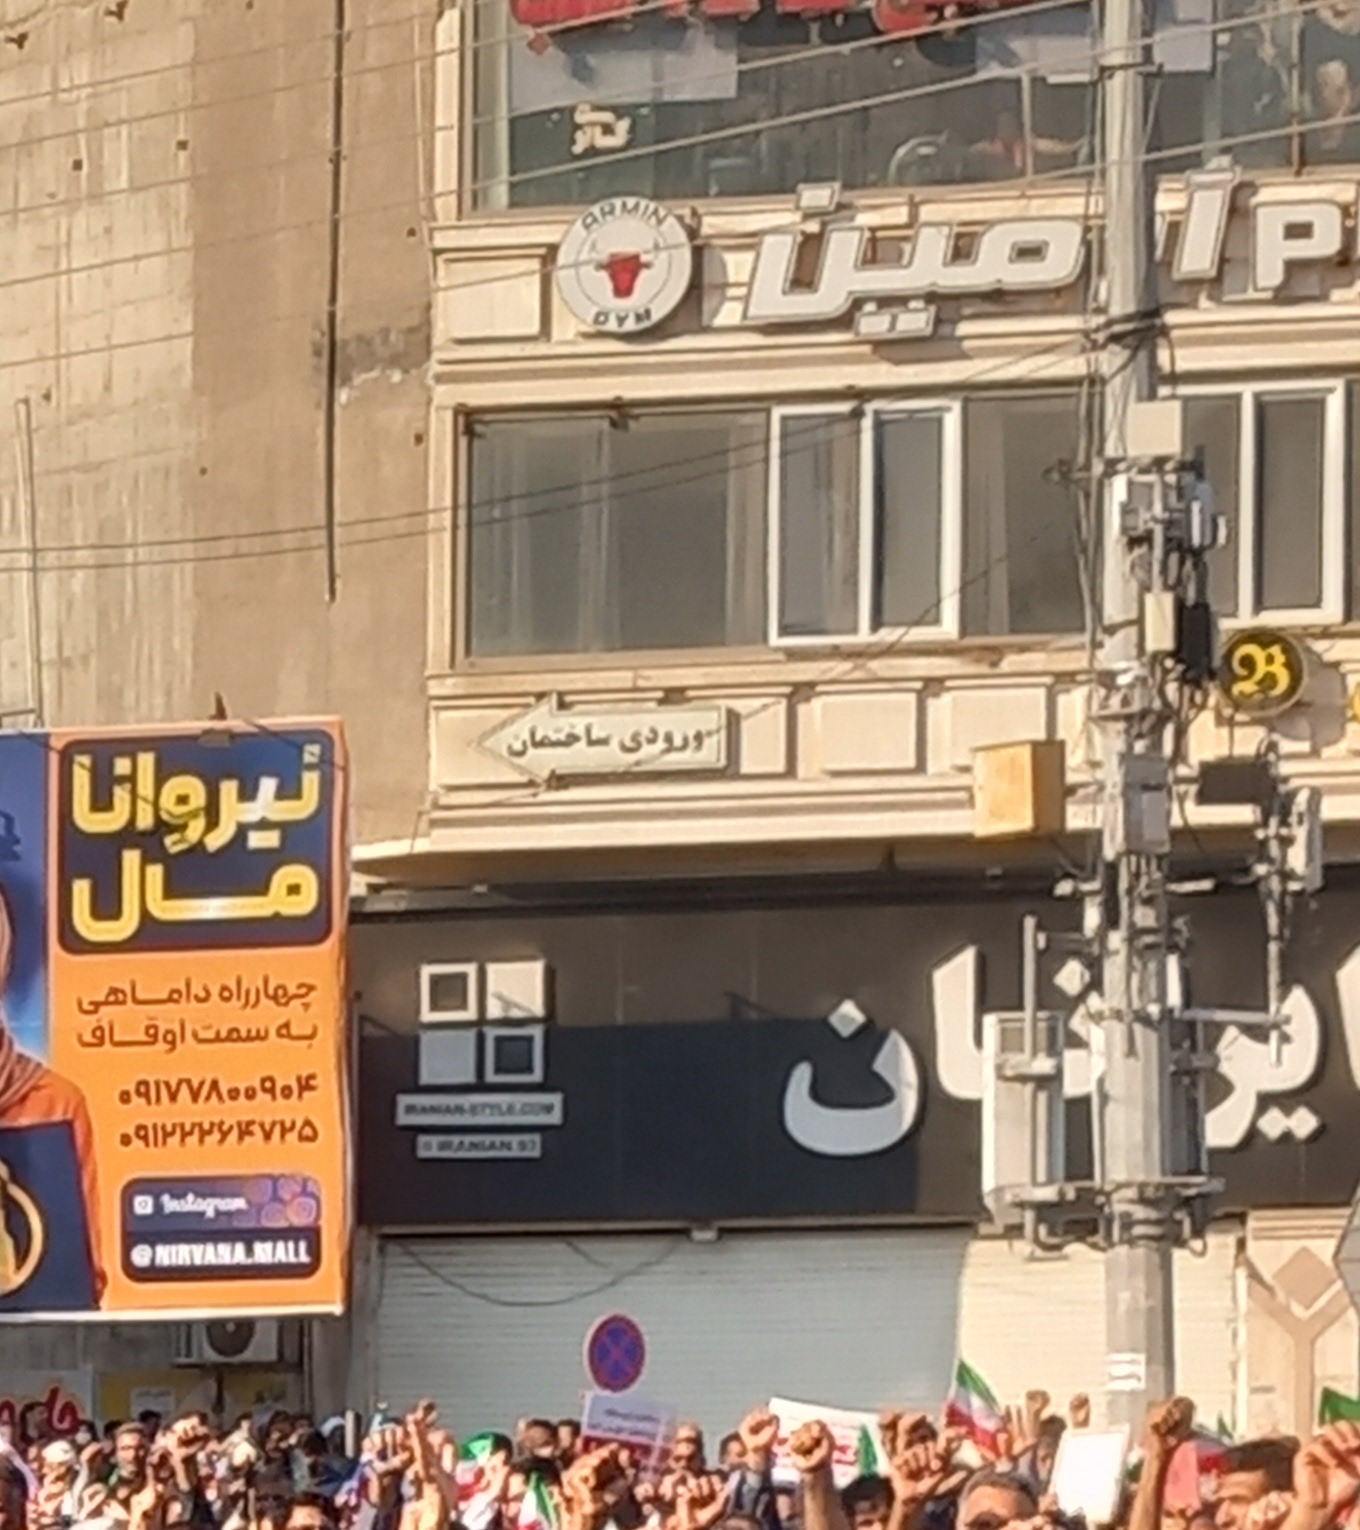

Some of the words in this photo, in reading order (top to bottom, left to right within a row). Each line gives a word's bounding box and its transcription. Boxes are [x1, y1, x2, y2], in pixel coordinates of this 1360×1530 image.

[581, 200, 670, 231] ARMIN
[506, 722, 611, 758] ساختمان
[618, 725, 704, 754] ورودی
[72, 743, 322, 854] نیروانا
[72, 849, 319, 942] مال
[76, 976, 211, 1015] داماهی
[217, 973, 318, 1014] چهارراه
[77, 1016, 186, 1055] اوقاف
[191, 1024, 270, 1046] سمت
[275, 1019, 319, 1050] به
[160, 1193, 249, 1219] Instagram
